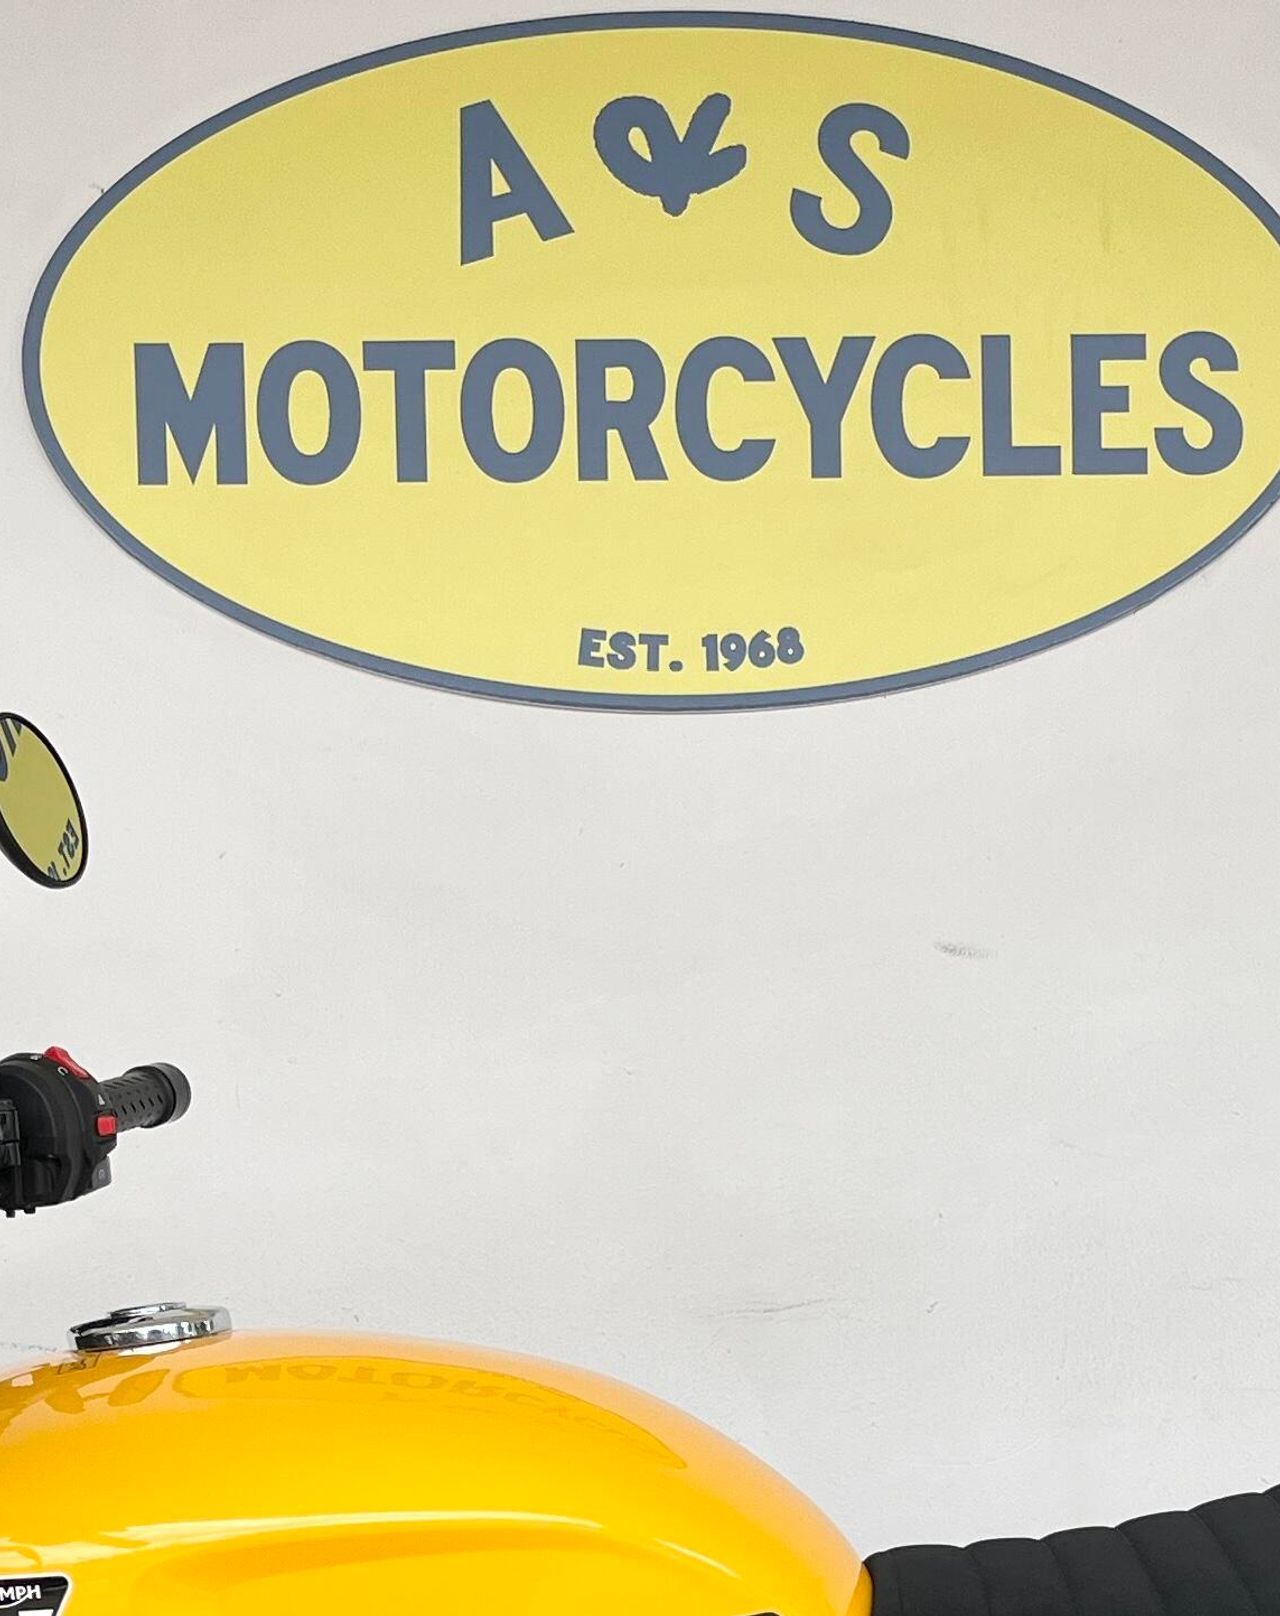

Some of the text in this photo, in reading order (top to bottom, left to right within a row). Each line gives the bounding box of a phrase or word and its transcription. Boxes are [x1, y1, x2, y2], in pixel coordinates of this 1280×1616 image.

[459, 99, 575, 266] A
[788, 101, 911, 257] S
[133, 329, 1245, 488] MOTORCYCLES
[578, 626, 804, 672] EST. 1968
